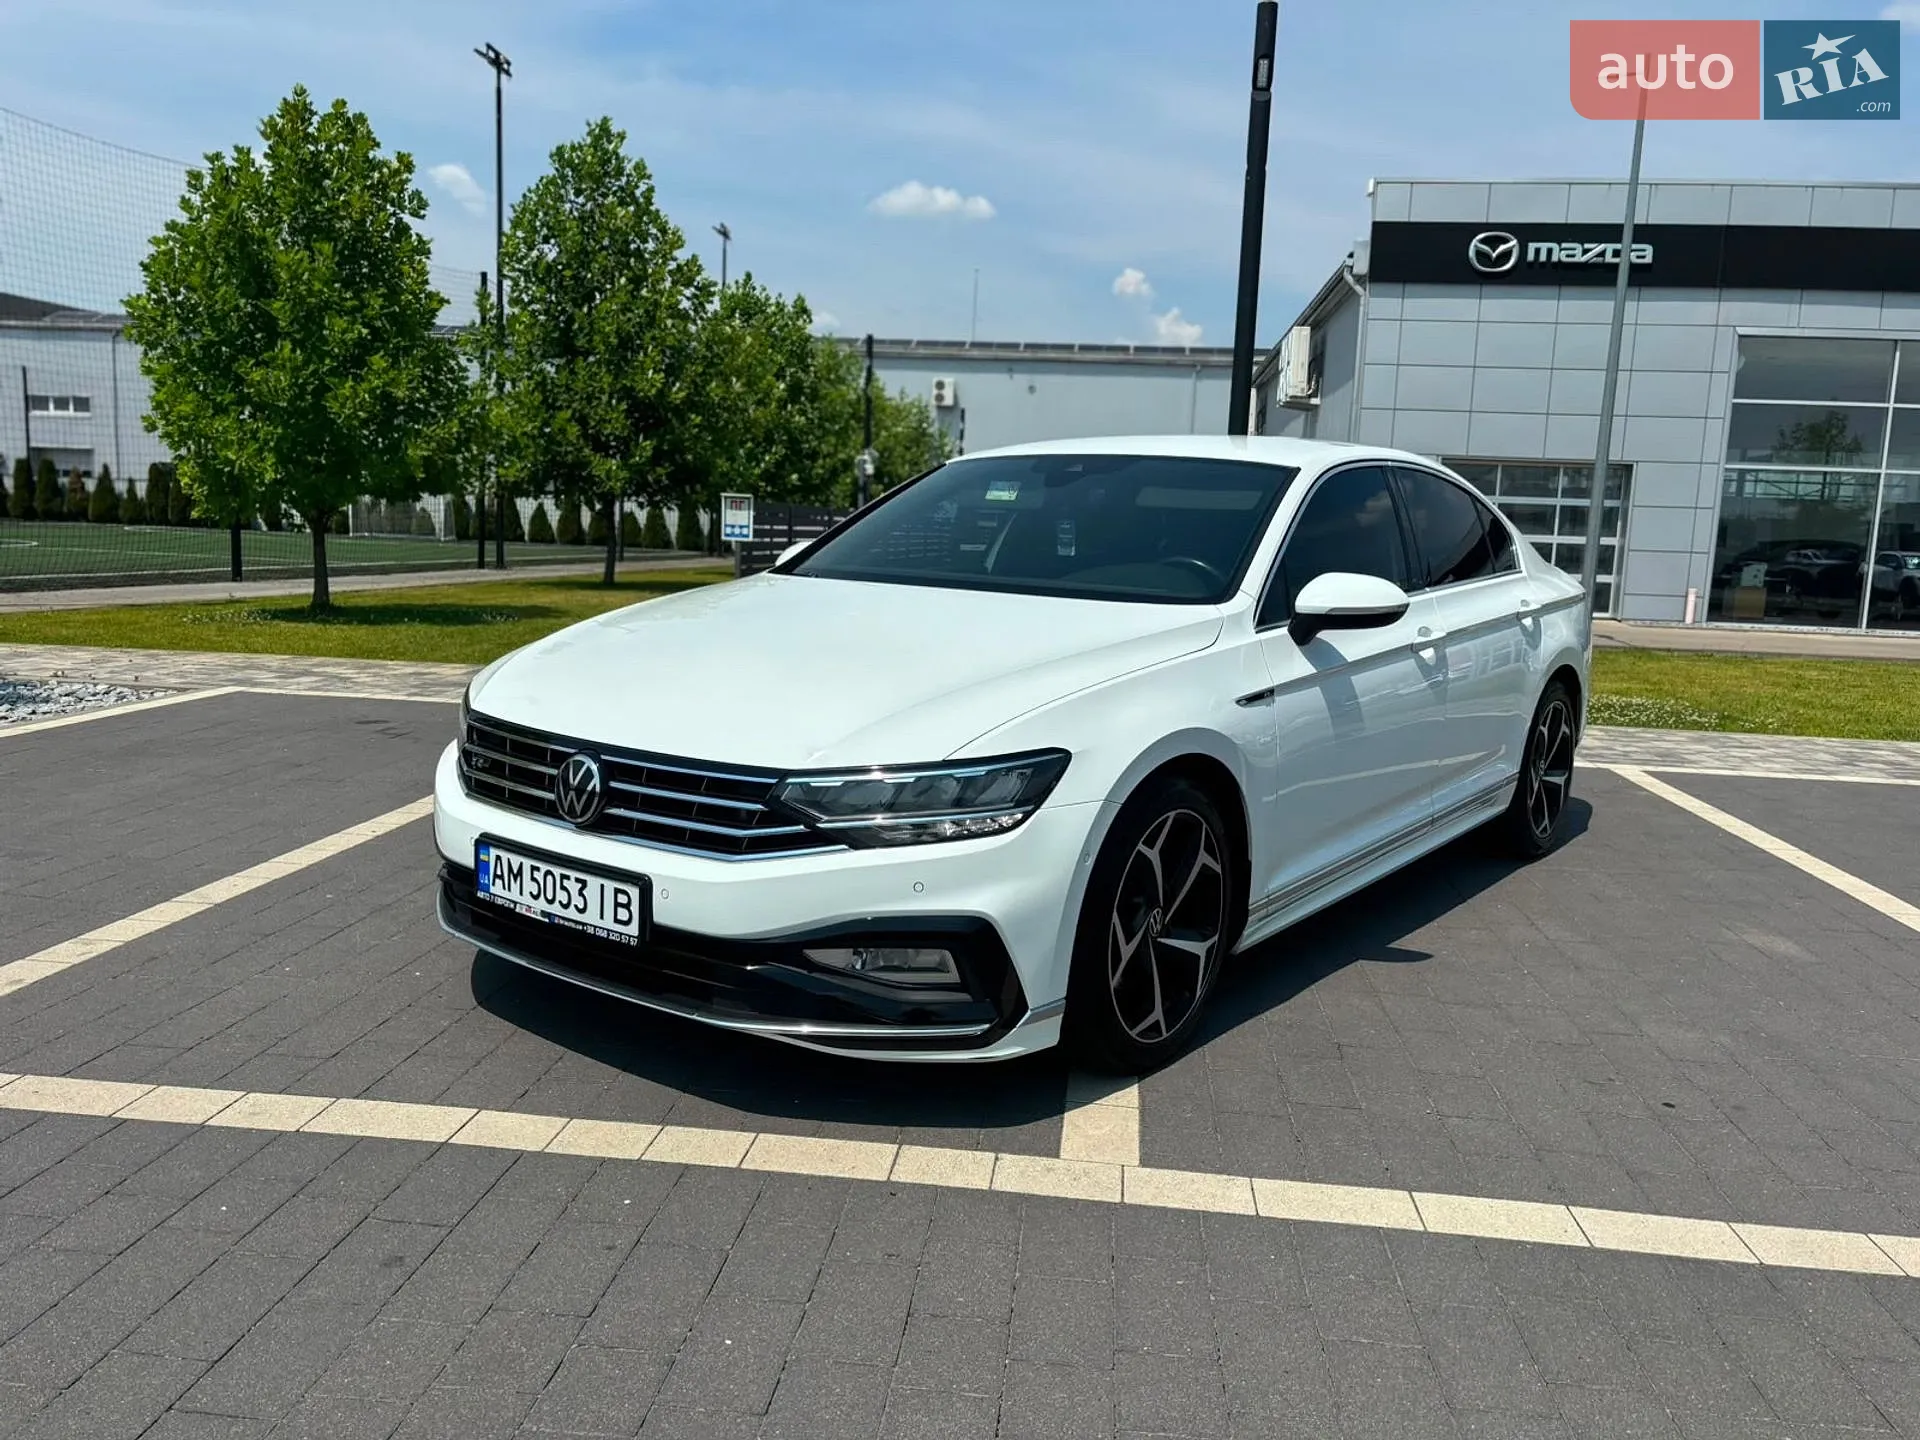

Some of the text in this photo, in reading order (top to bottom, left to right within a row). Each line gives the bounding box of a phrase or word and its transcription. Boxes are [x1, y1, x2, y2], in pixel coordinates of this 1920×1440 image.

[491, 855, 524, 896] AM
[529, 865, 588, 914] 5053
[599, 883, 633, 926] IB
